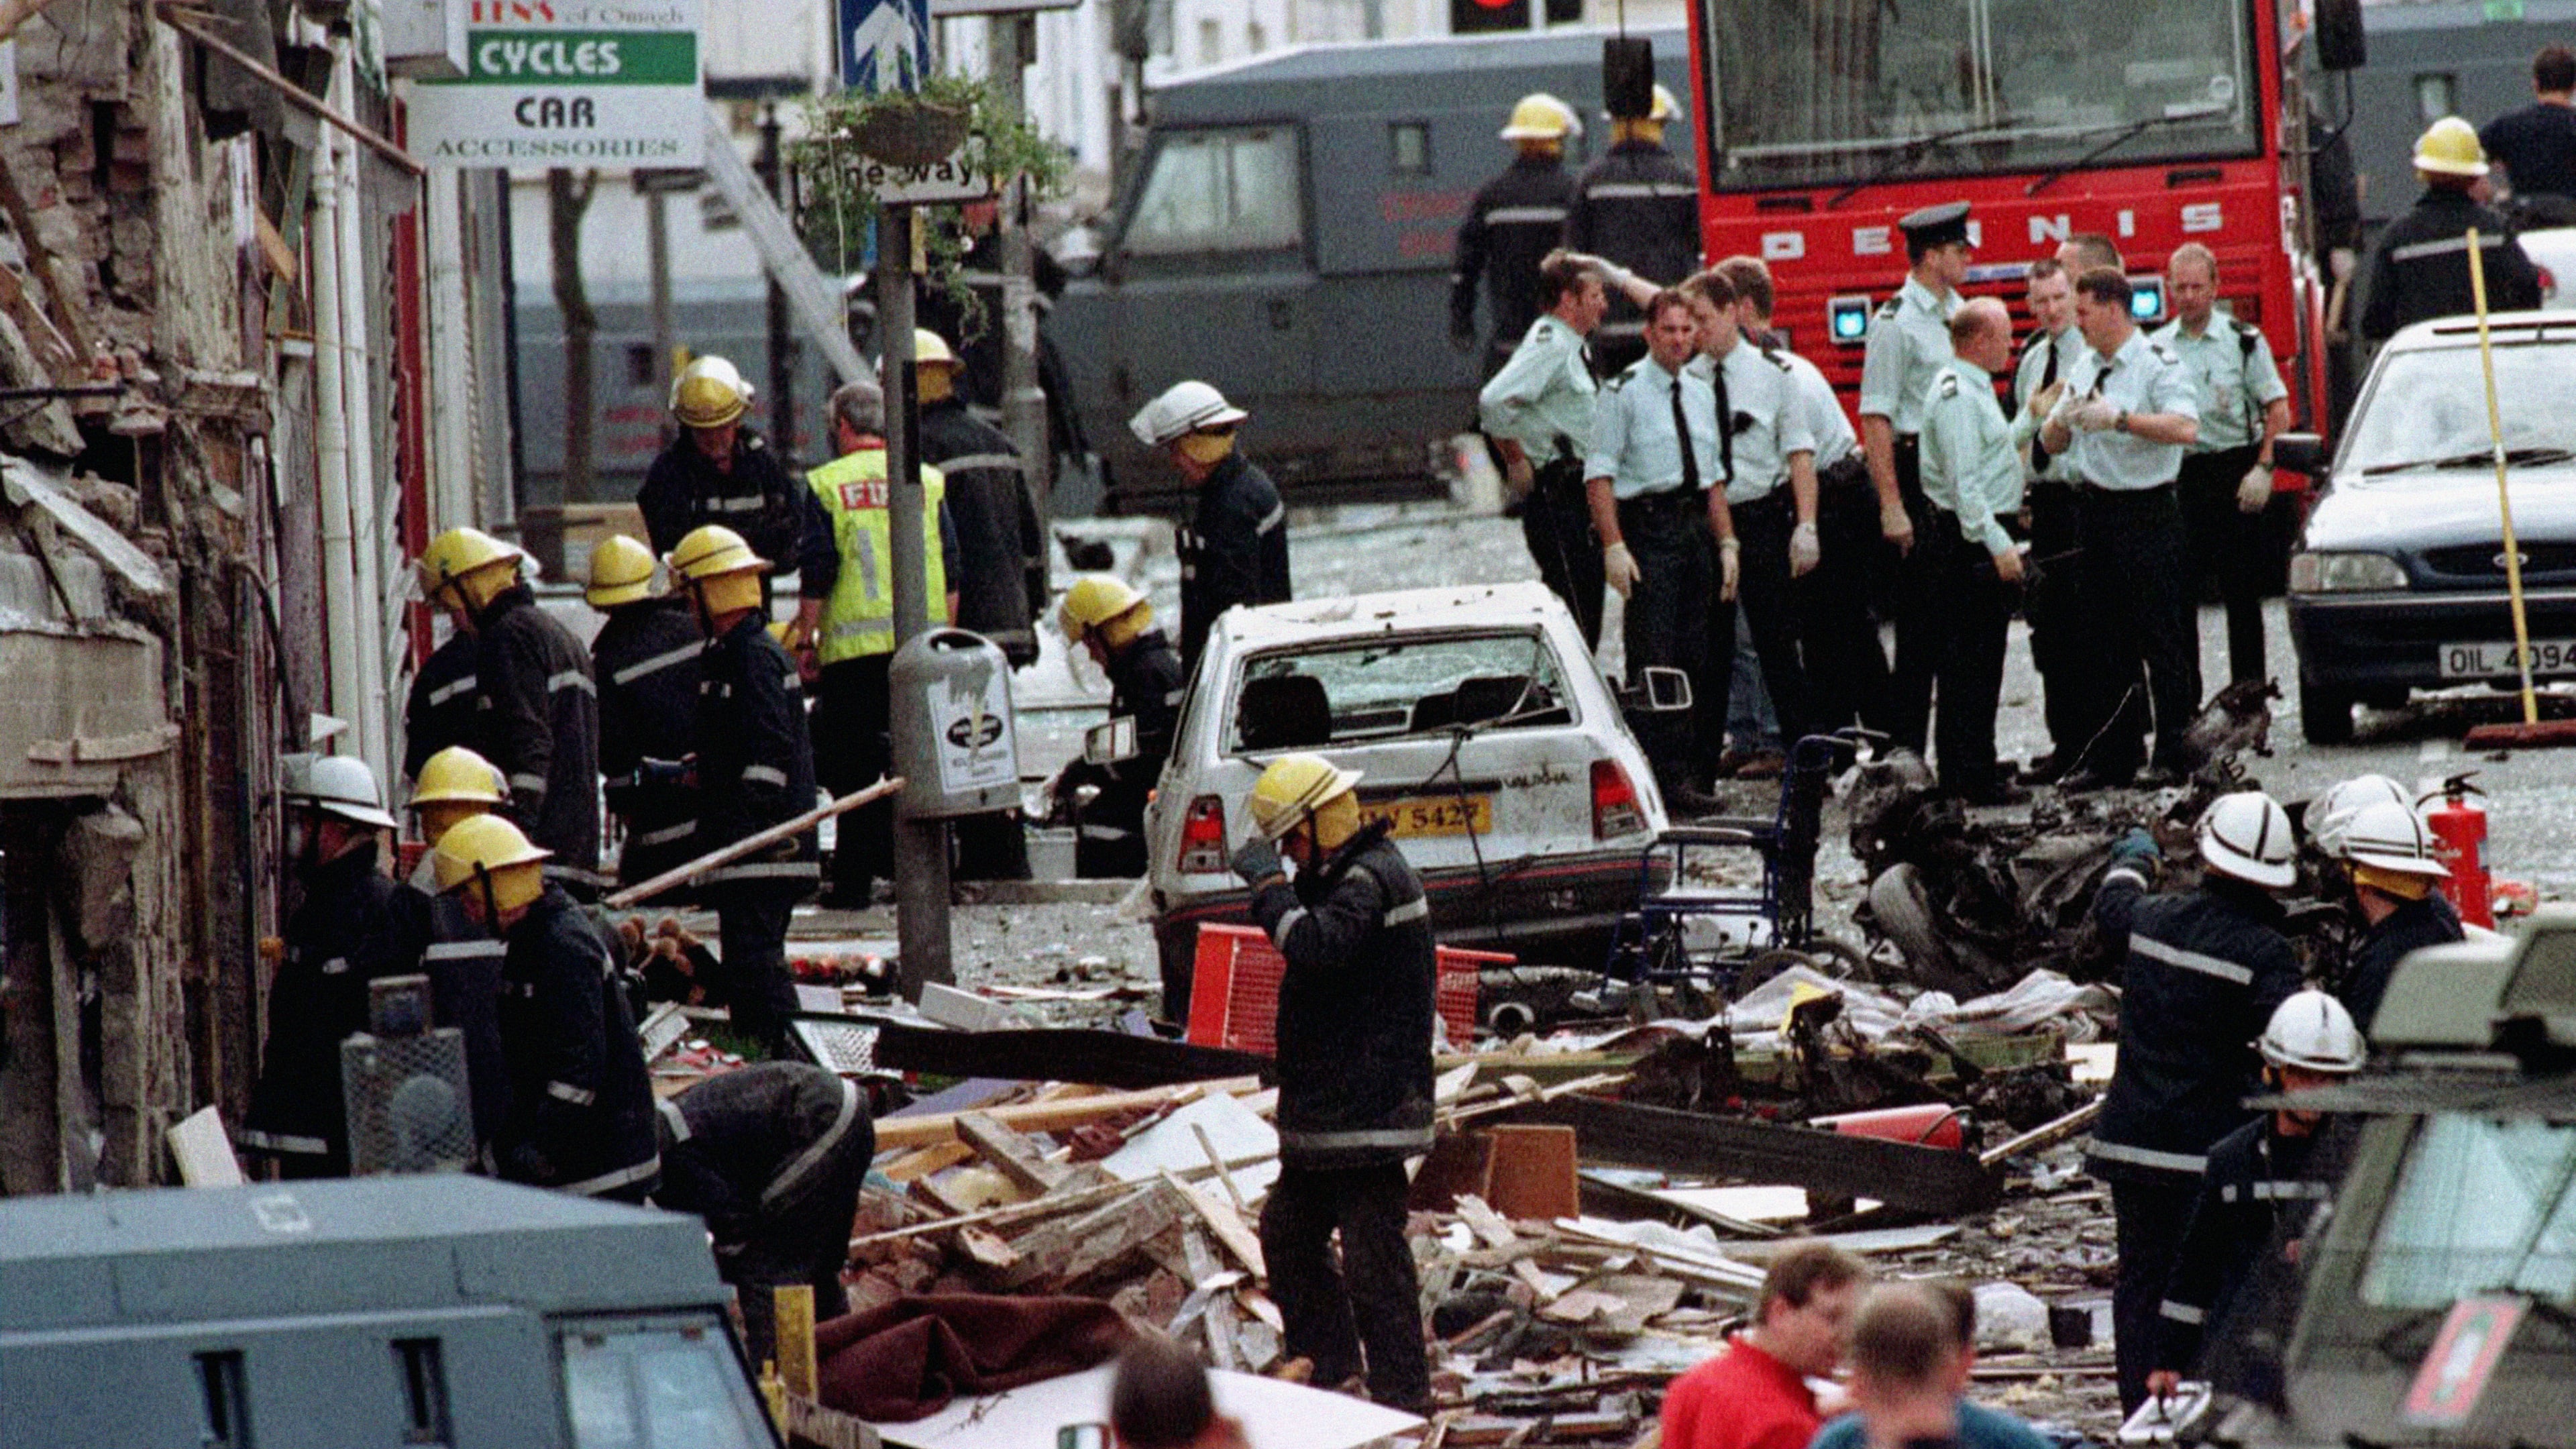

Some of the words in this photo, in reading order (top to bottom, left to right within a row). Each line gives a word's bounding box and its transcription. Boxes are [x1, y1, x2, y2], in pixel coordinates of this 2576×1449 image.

[478, 40, 621, 75] CYCLES
[515, 96, 594, 127] CAR
[435, 138, 678, 156] ACCESSORIES
[1762, 203, 2223, 260] DENIS
[2451, 649, 2493, 672] OIL
